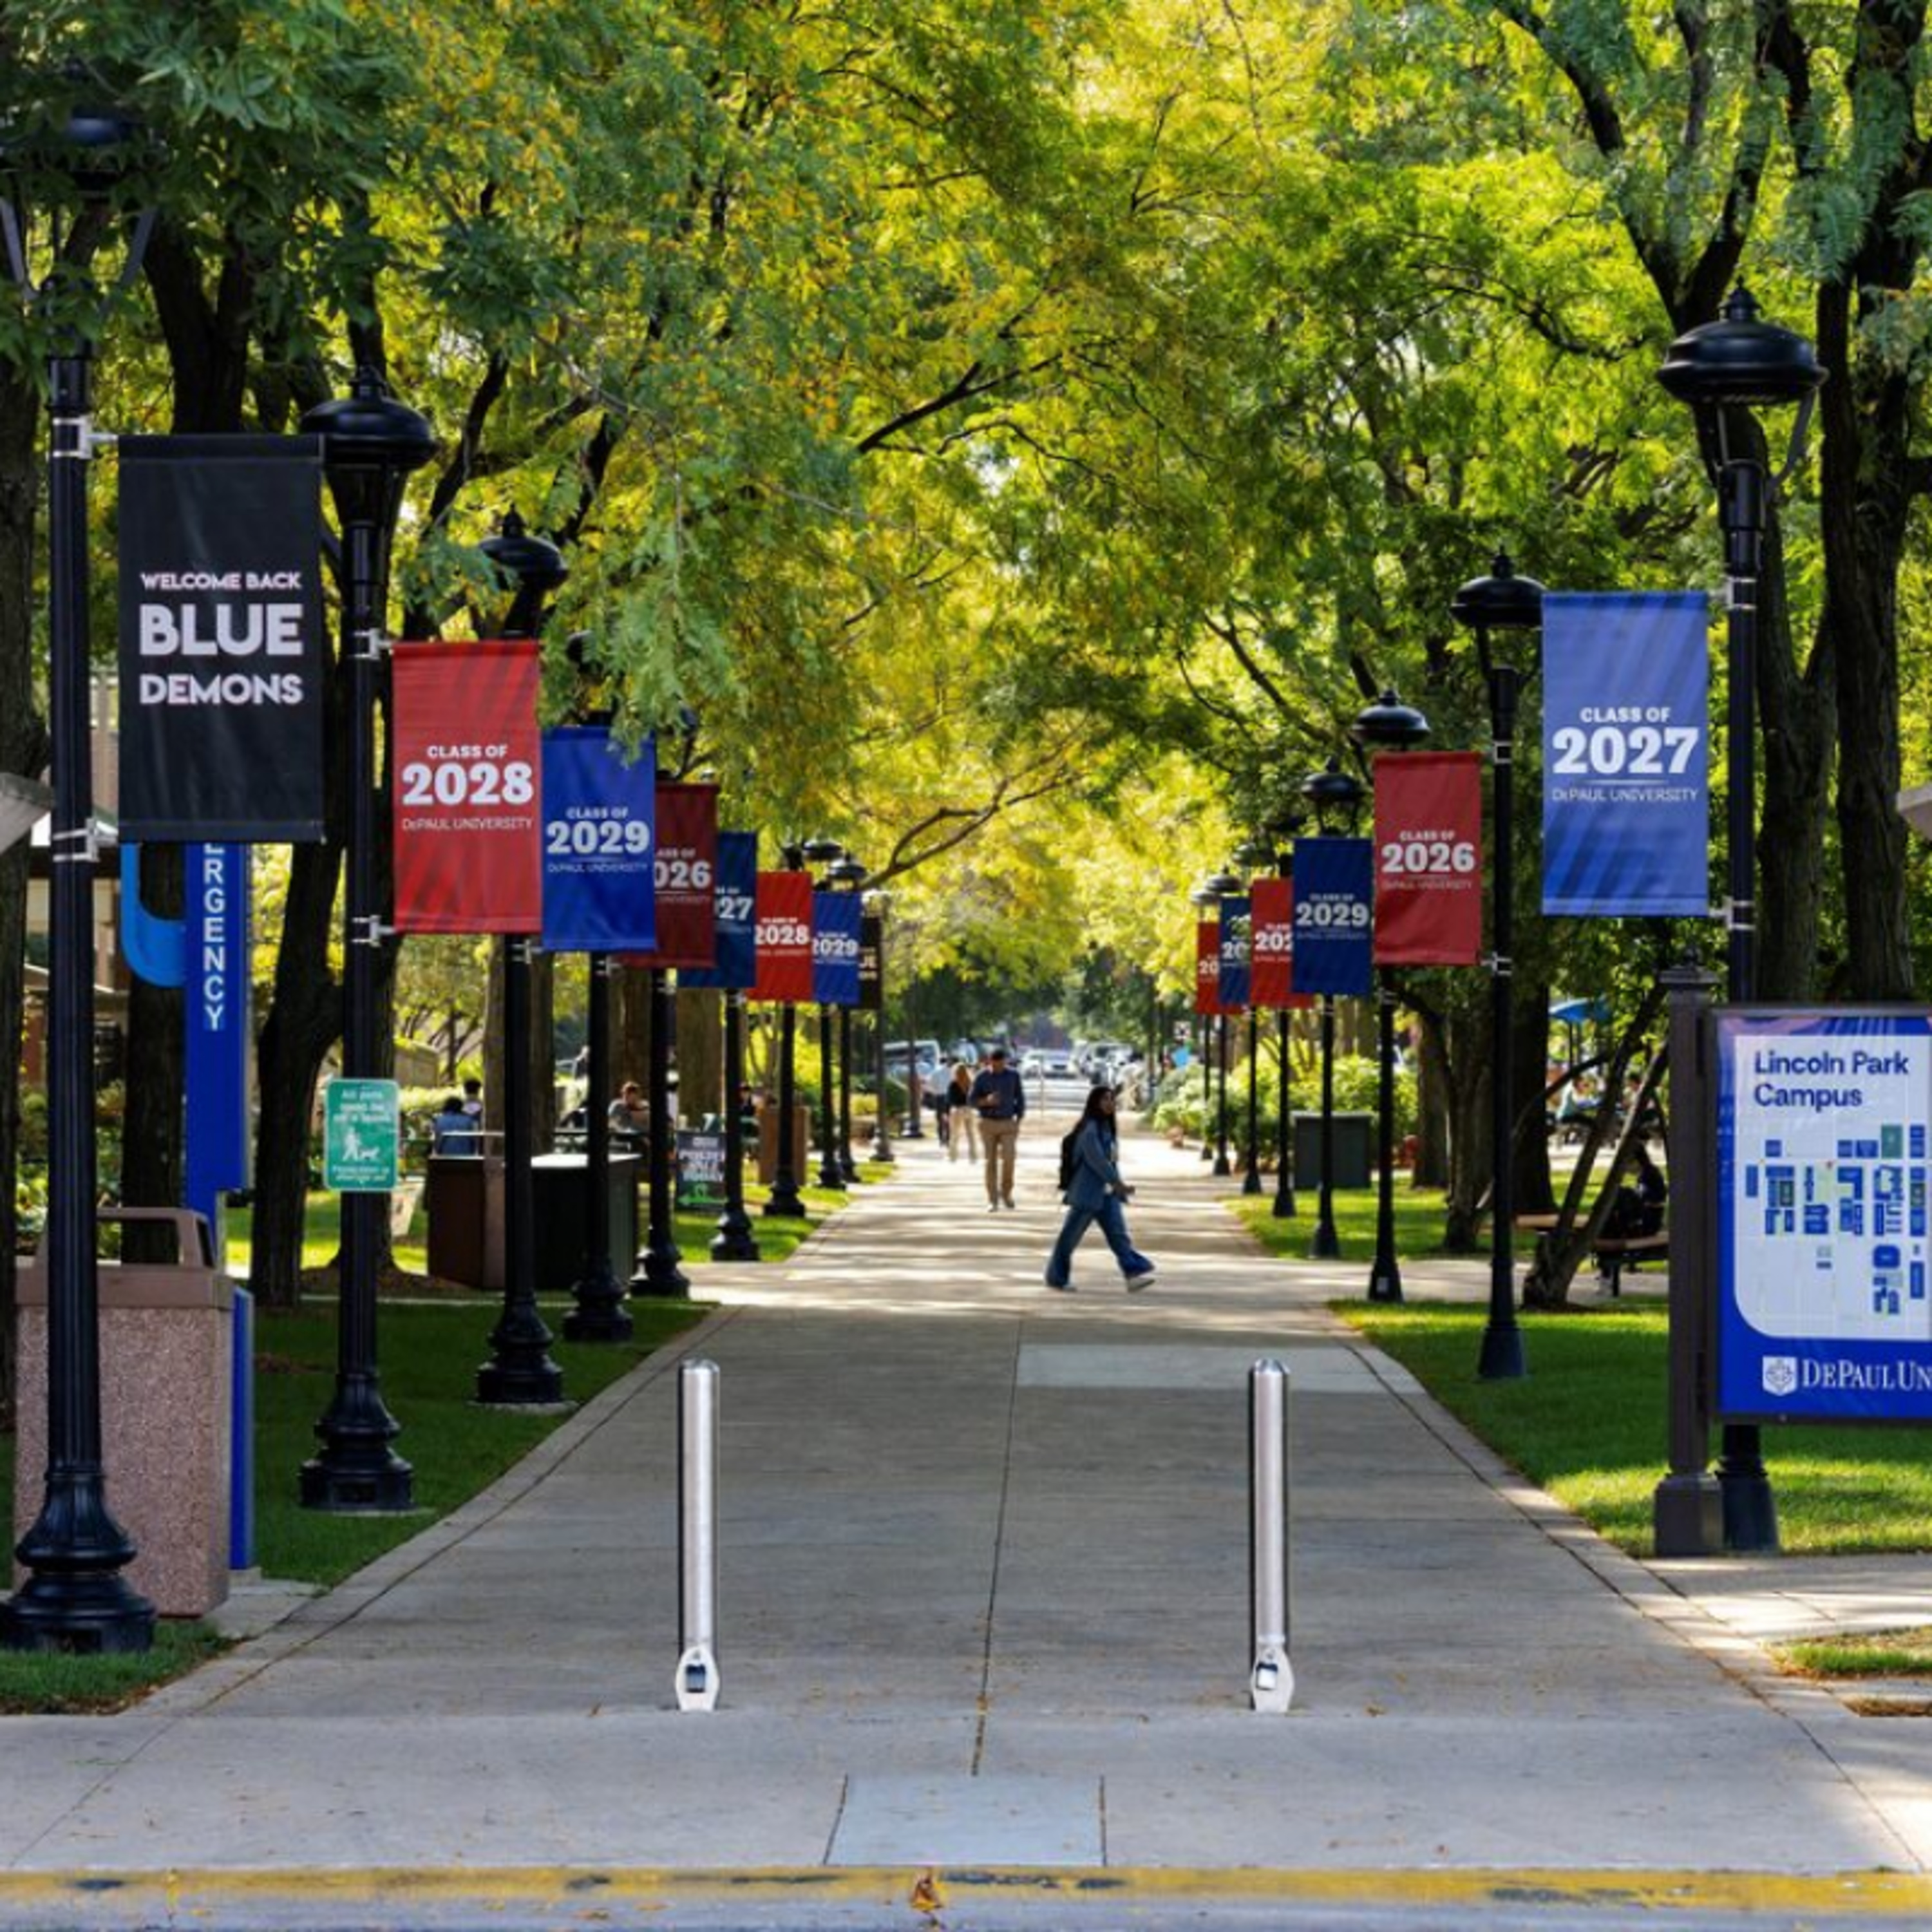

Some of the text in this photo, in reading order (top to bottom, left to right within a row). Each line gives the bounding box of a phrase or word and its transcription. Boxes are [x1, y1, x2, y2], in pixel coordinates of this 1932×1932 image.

[140, 572, 302, 589] WELCOME BACK
[140, 603, 303, 656] BLUE
[140, 674, 303, 705] DEMONS
[1580, 707, 1671, 723] CLASS OF
[426, 744, 507, 759] CLASS OF
[1552, 726, 1699, 773] 2027
[402, 762, 534, 805] 2028
[1610, 788, 1698, 801] UNIVERSITY
[454, 817, 533, 830] UNIVERSITY
[565, 806, 629, 819] CLASS OF
[547, 820, 650, 854] 2029
[1381, 842, 1475, 873] 2026
[654, 860, 712, 889] 026
[715, 896, 753, 920] 27
[1296, 902, 1370, 927] 2029
[204, 843, 225, 1031] RGENCY
[754, 924, 810, 945] 2028
[1255, 931, 1293, 952] 202
[1222, 941, 1247, 960] 20
[1198, 960, 1220, 974] 20
[1755, 1050, 1909, 1074] Lincoln Park
[1754, 1083, 1862, 1113] Campus
